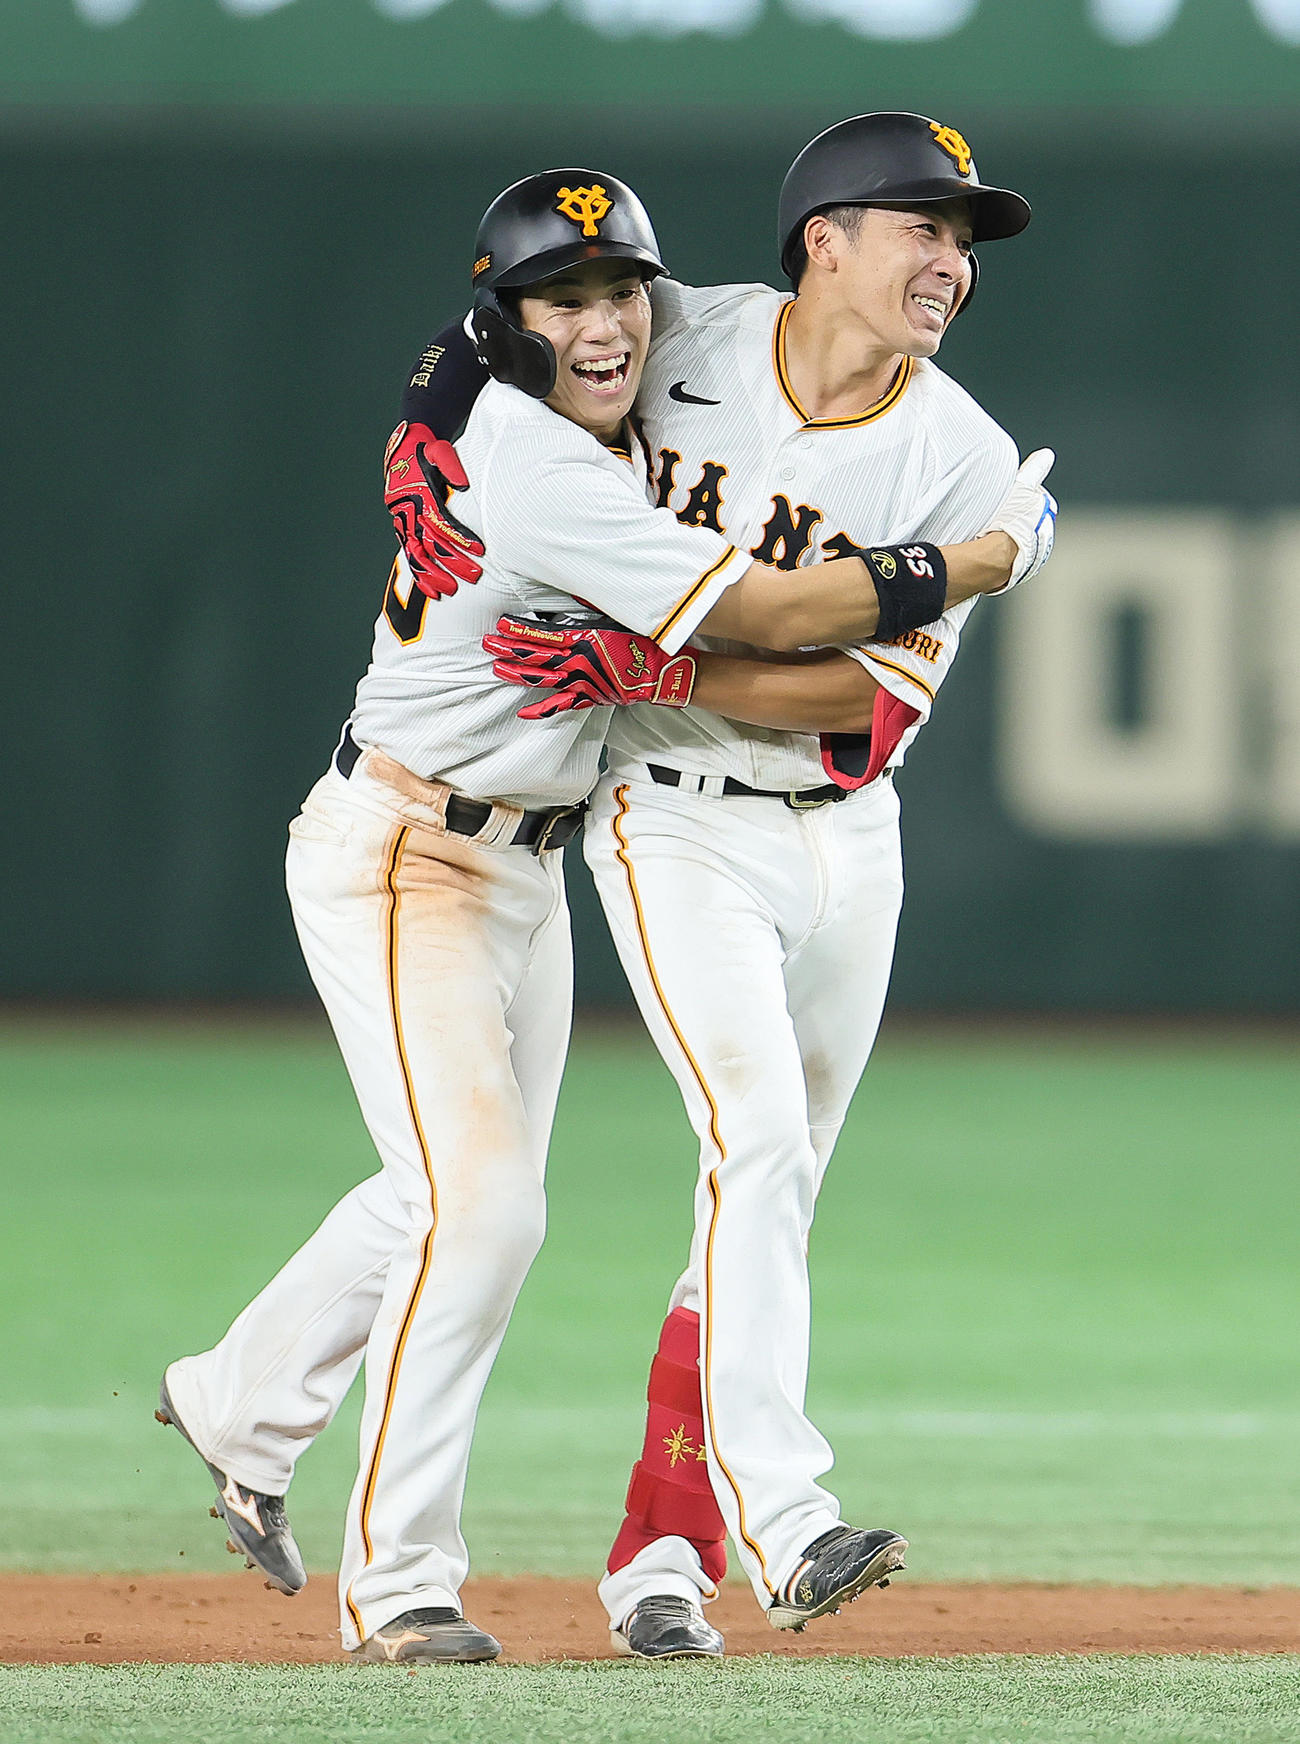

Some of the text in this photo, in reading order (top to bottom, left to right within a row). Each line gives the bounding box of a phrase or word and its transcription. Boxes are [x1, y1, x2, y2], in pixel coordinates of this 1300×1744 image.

[409, 344, 446, 388] Daiki
[898, 545, 935, 580] 35
[523, 627, 565, 643] Professional
